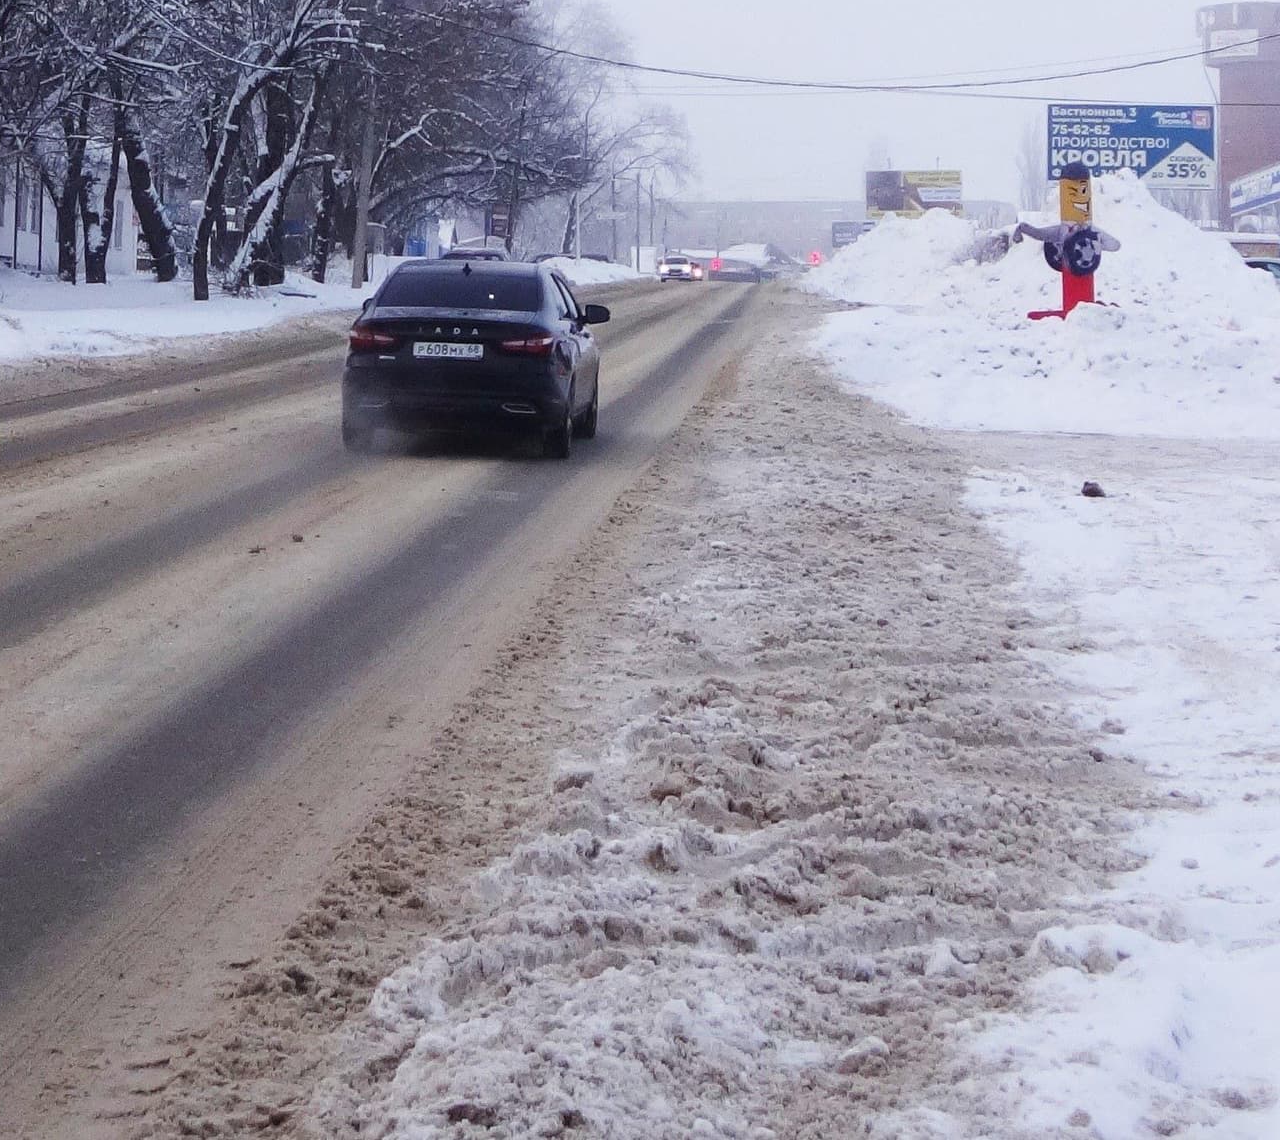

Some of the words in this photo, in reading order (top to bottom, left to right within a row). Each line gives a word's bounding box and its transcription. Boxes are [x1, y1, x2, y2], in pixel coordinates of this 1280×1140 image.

[1052, 107, 1126, 118] Бастионная,
[1129, 108, 1137, 116] 3
[1052, 124, 1111, 135] 75-62-62
[1052, 137, 1169, 149] ПРОИЗВОДСТВО!
[1052, 150, 1147, 167] КРОВЛЯ
